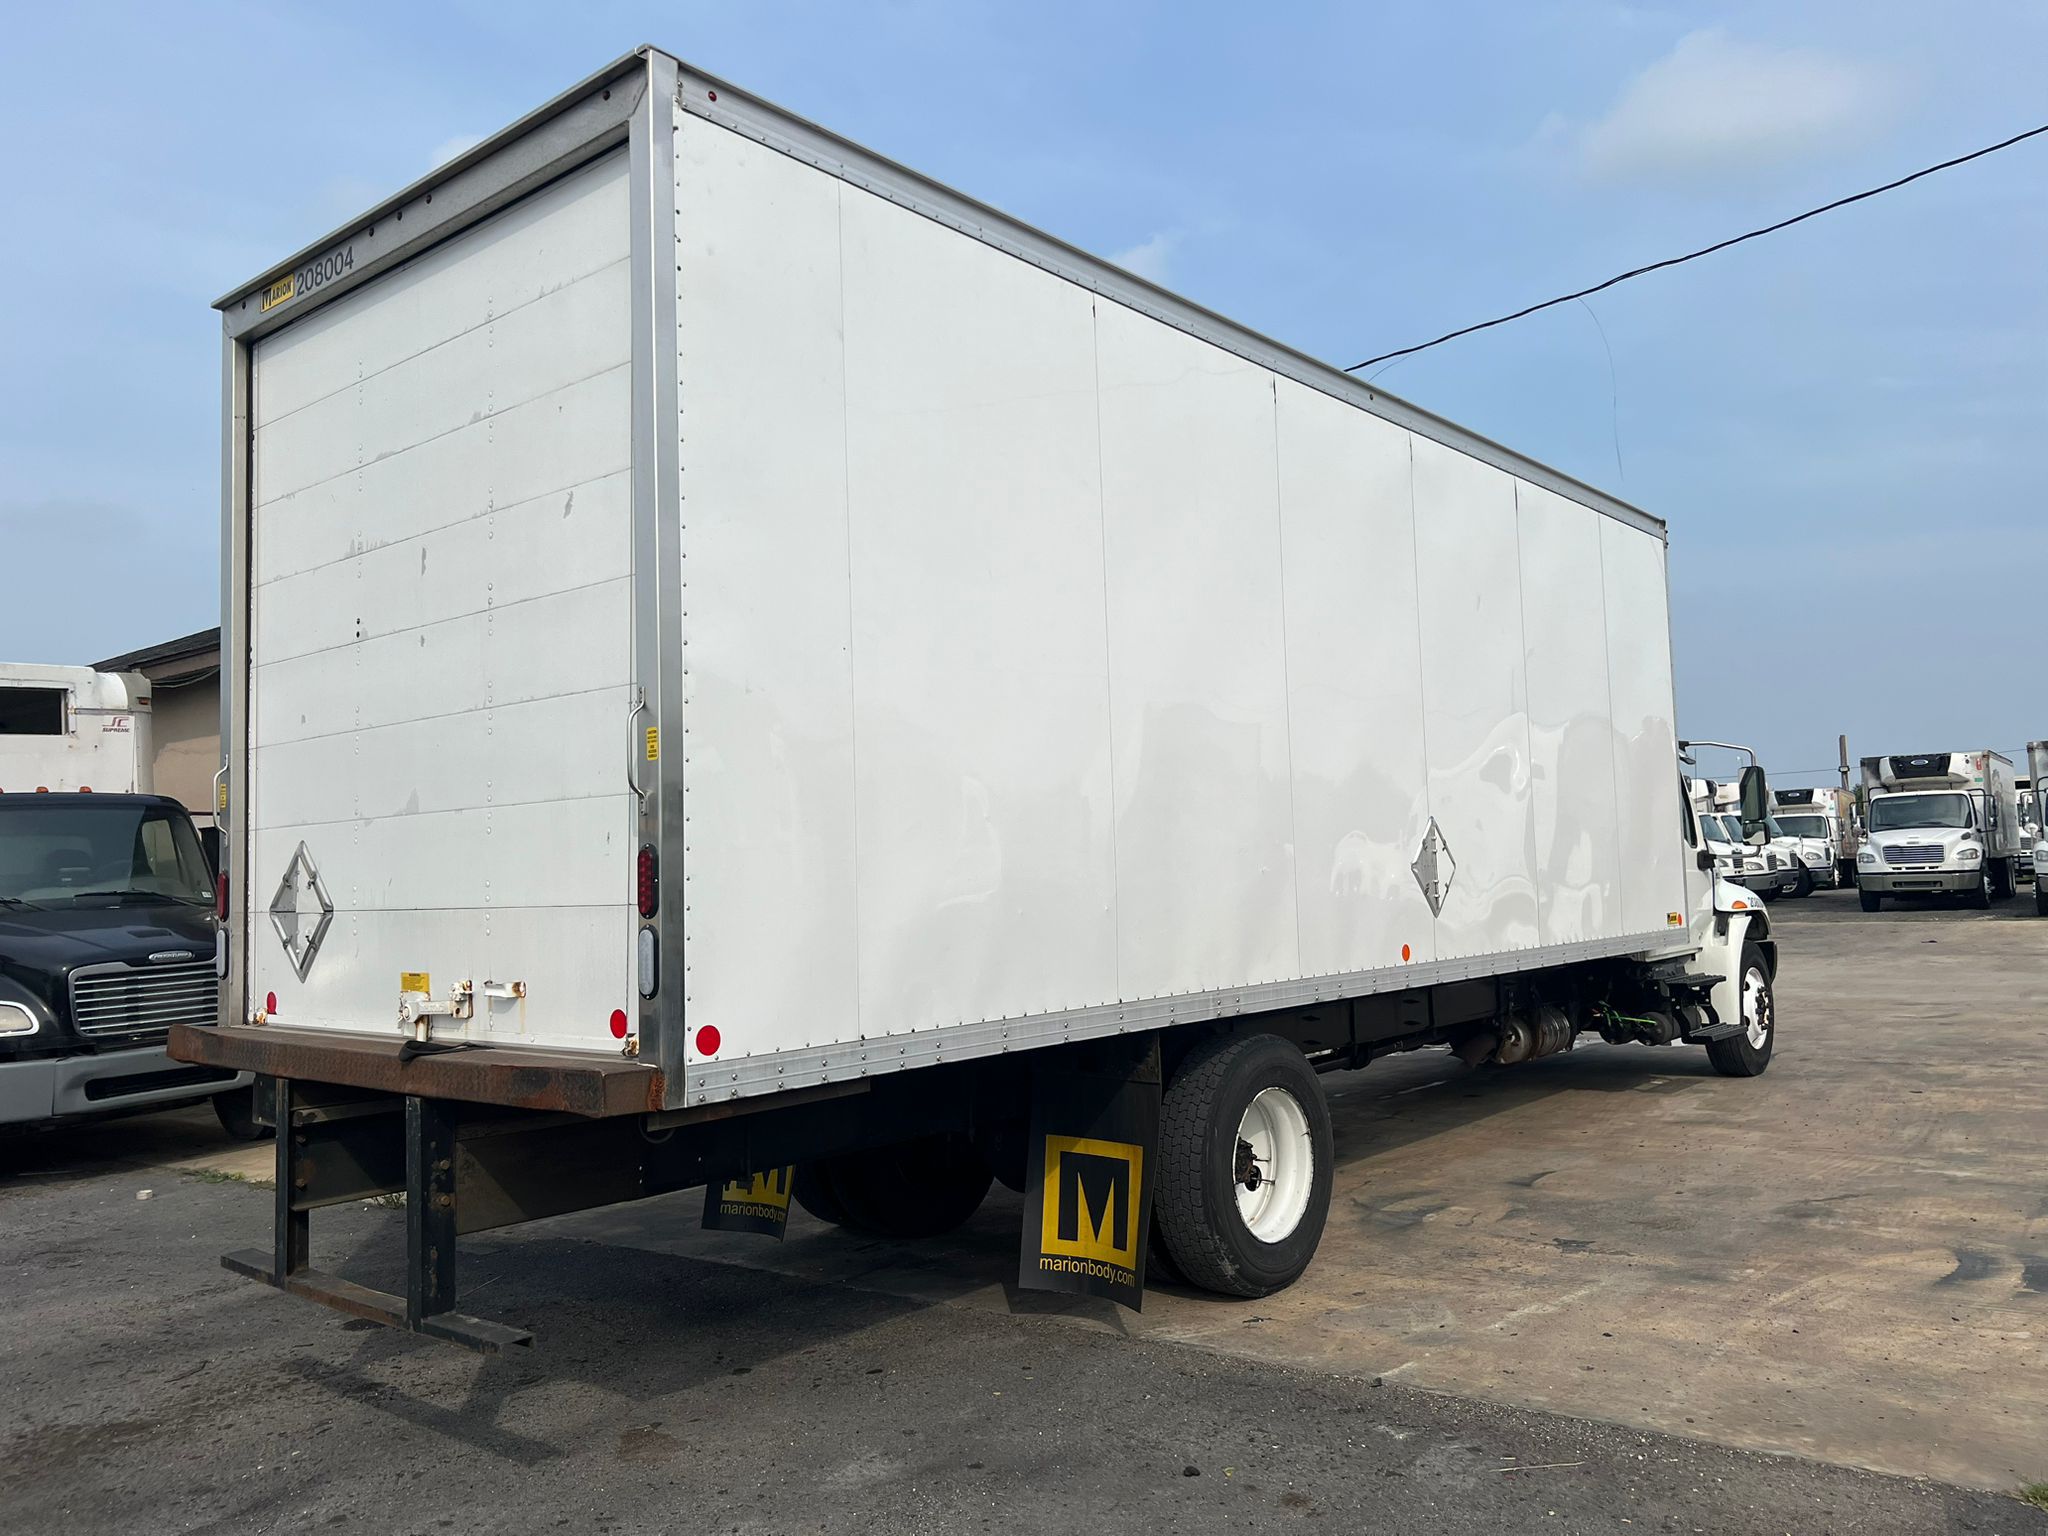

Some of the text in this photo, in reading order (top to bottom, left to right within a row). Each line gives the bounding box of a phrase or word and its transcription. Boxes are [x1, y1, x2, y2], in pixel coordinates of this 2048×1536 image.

[262, 245, 354, 310] MARION 208004
[1057, 1150, 1130, 1251] M
[1039, 1256, 1134, 1287] marionbody.com
